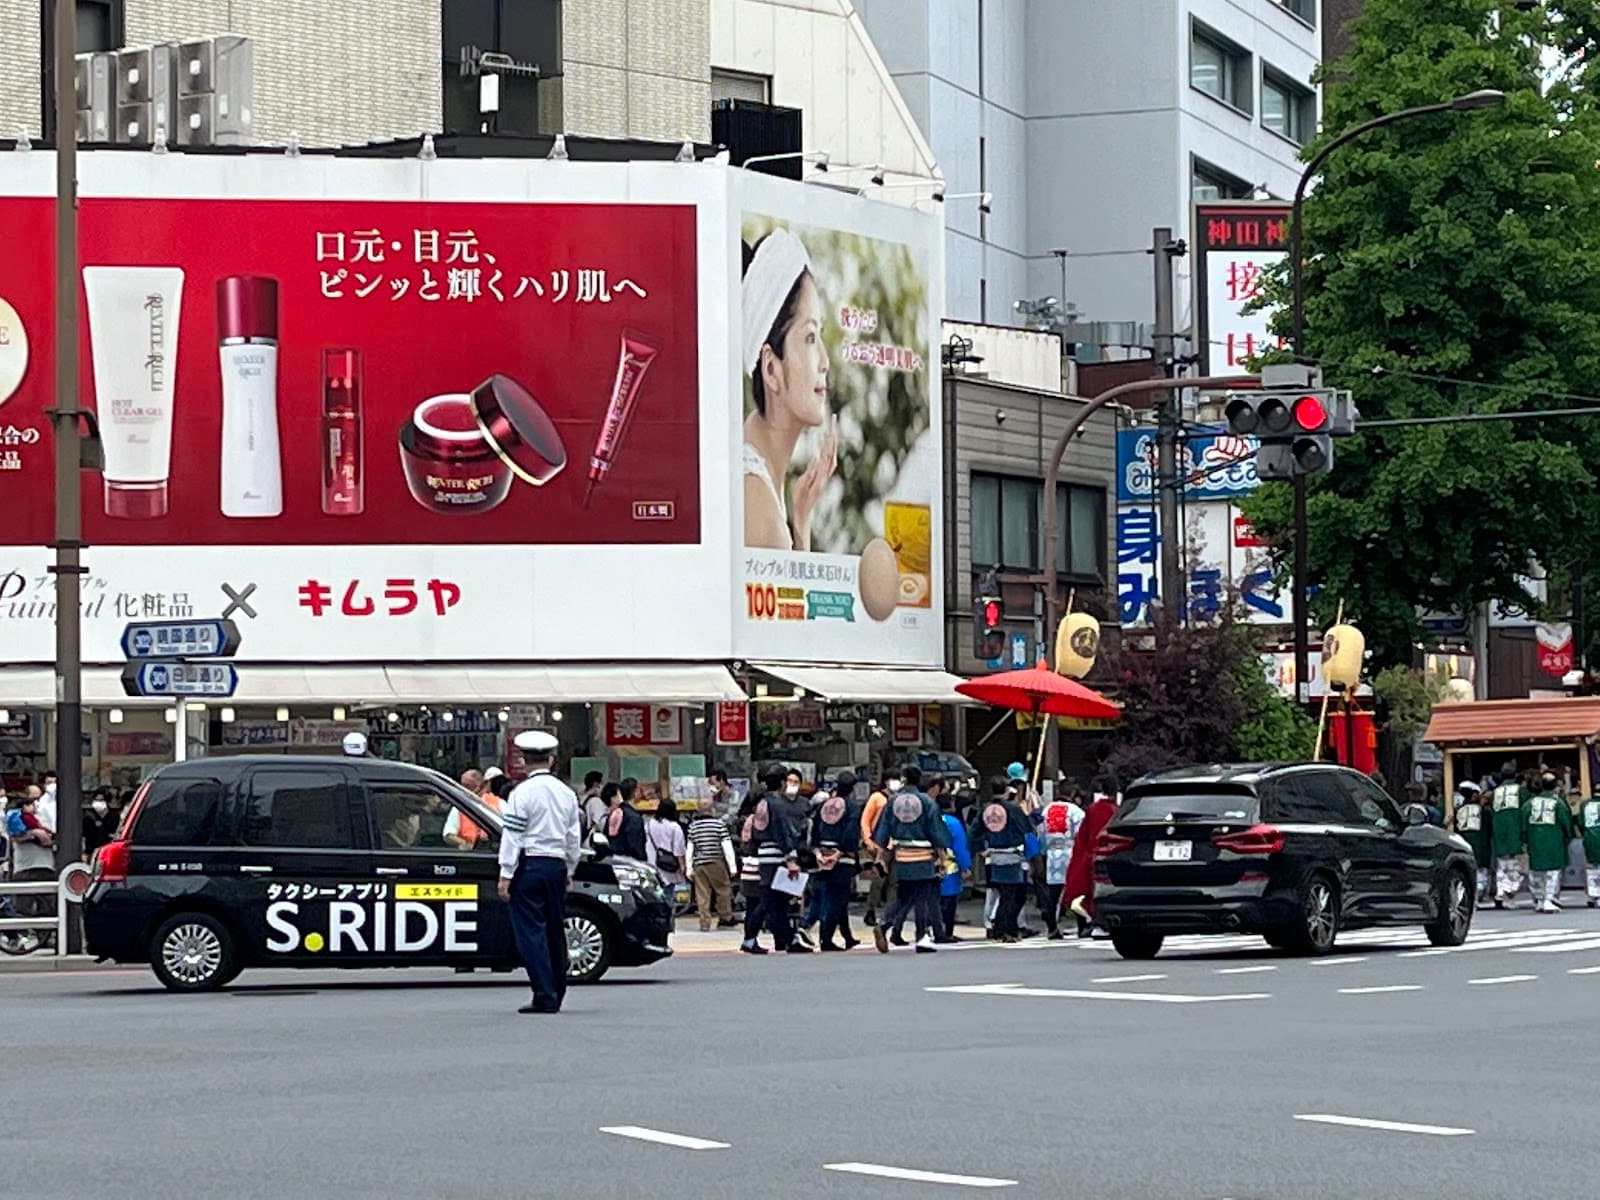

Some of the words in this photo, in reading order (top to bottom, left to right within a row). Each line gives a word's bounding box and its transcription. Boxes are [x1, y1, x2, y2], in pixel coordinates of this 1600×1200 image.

[315, 228, 498, 263] 口元・目元、
[319, 269, 647, 302] ピンッと輝くハリ肌へ
[0, 425, 40, 445] 合の
[115, 593, 194, 618] 化粧品
[298, 579, 461, 616] キムラヤ
[267, 884, 388, 900] タクシーアプリ
[410, 887, 464, 897] エスライド
[266, 901, 478, 952] S.RIDE
